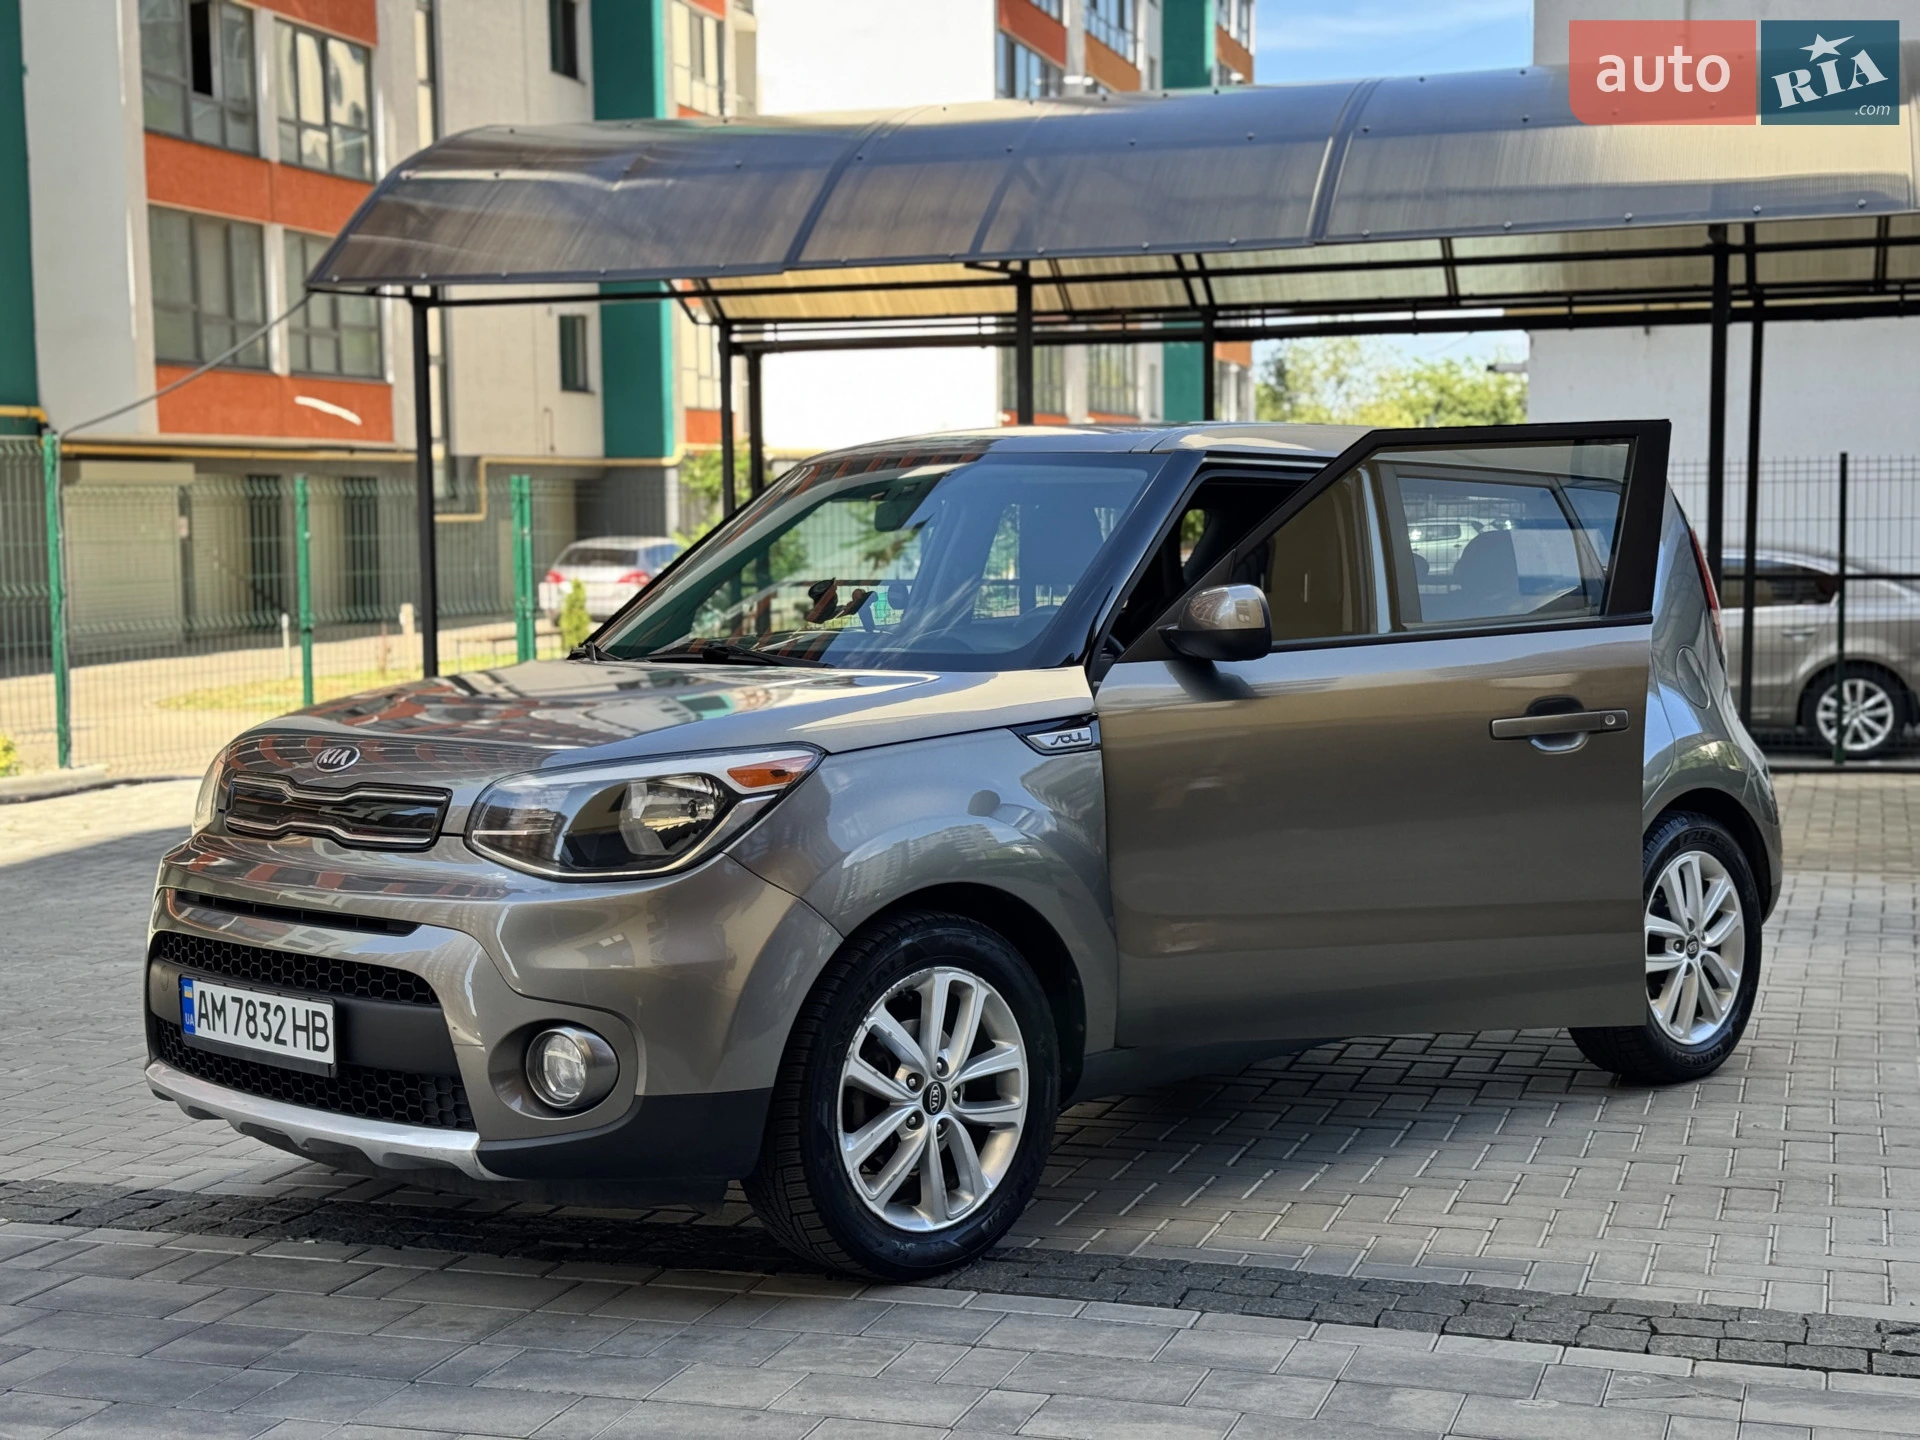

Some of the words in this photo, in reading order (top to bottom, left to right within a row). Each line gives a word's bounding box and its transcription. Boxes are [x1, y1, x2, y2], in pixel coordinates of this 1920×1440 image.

[318, 748, 352, 766] KIA
[184, 1012, 195, 1026] UA
[931, 1089, 939, 1109] KIA
